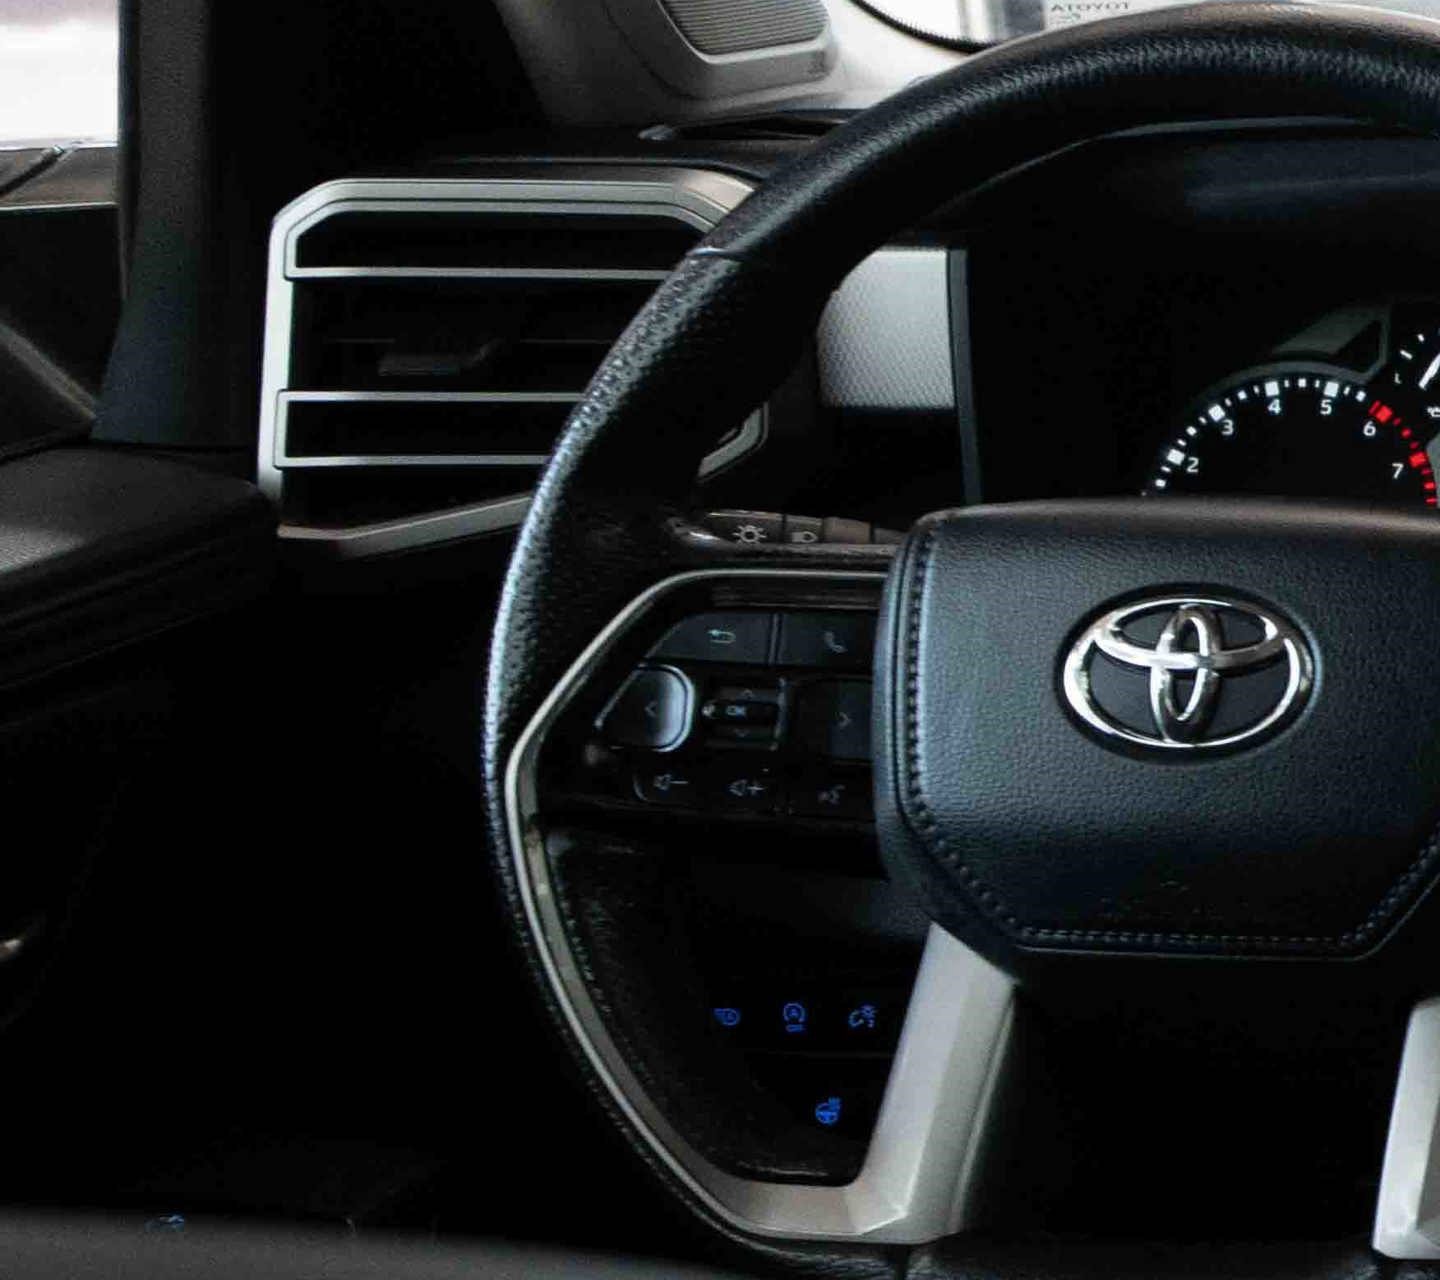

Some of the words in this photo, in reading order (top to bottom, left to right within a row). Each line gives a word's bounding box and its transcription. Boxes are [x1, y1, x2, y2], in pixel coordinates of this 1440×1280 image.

[1267, 399, 1281, 415] 4
[1319, 400, 1333, 416] 5
[1220, 420, 1235, 437] 3
[1363, 420, 1377, 437] 6
[1186, 457, 1200, 473] 2
[1391, 462, 1404, 479] 7
